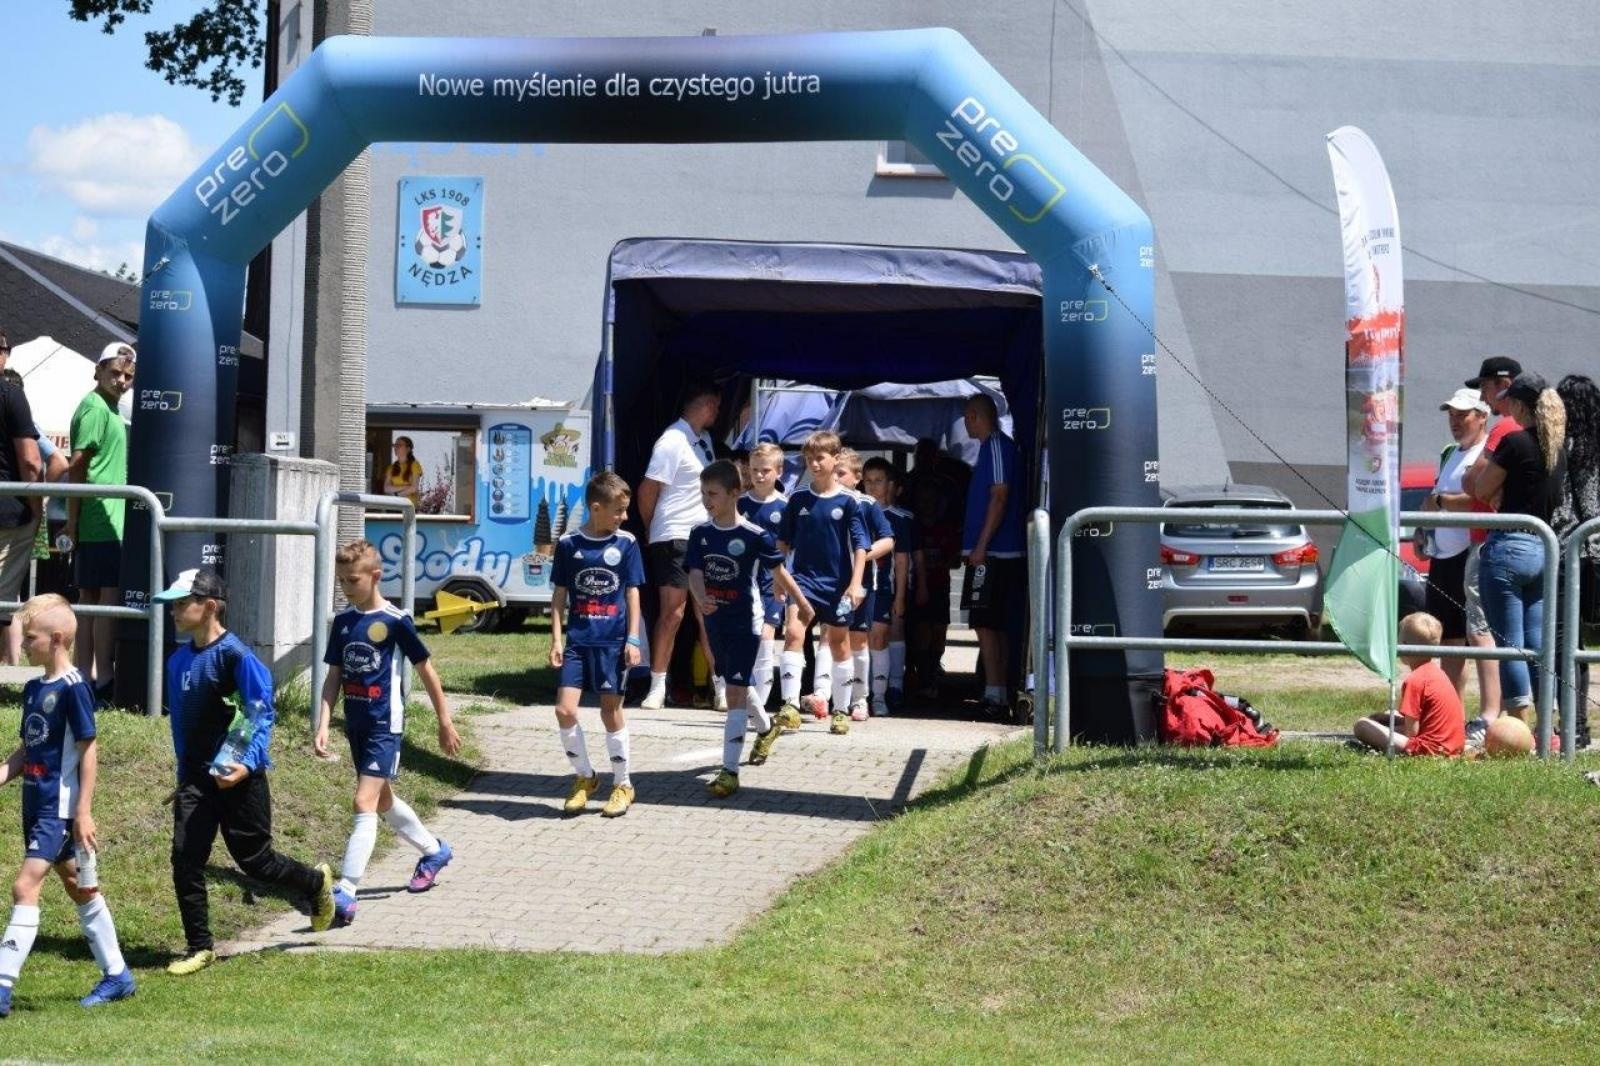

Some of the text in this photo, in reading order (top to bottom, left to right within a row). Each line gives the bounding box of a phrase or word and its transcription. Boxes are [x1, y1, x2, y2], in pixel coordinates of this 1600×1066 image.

[418, 71, 820, 102] Nowe myślenie dla czystego jutra
[951, 97, 1018, 156] pre
[936, 120, 1014, 201] zero
[195, 146, 248, 206] pre
[211, 150, 288, 226] zero
[414, 188, 470, 206] LKS 1908
[408, 262, 472, 288] NĘDZA
[150, 290, 170, 300] pre
[150, 301, 178, 310] zero
[1060, 300, 1085, 312] pre
[1061, 312, 1094, 322] zero
[141, 389, 160, 398] pre
[140, 400, 168, 410] zero
[1064, 408, 1086, 420] pre
[1064, 420, 1096, 430] zero
[1074, 527, 1100, 536] ero
[182, 670, 191, 691] 12
